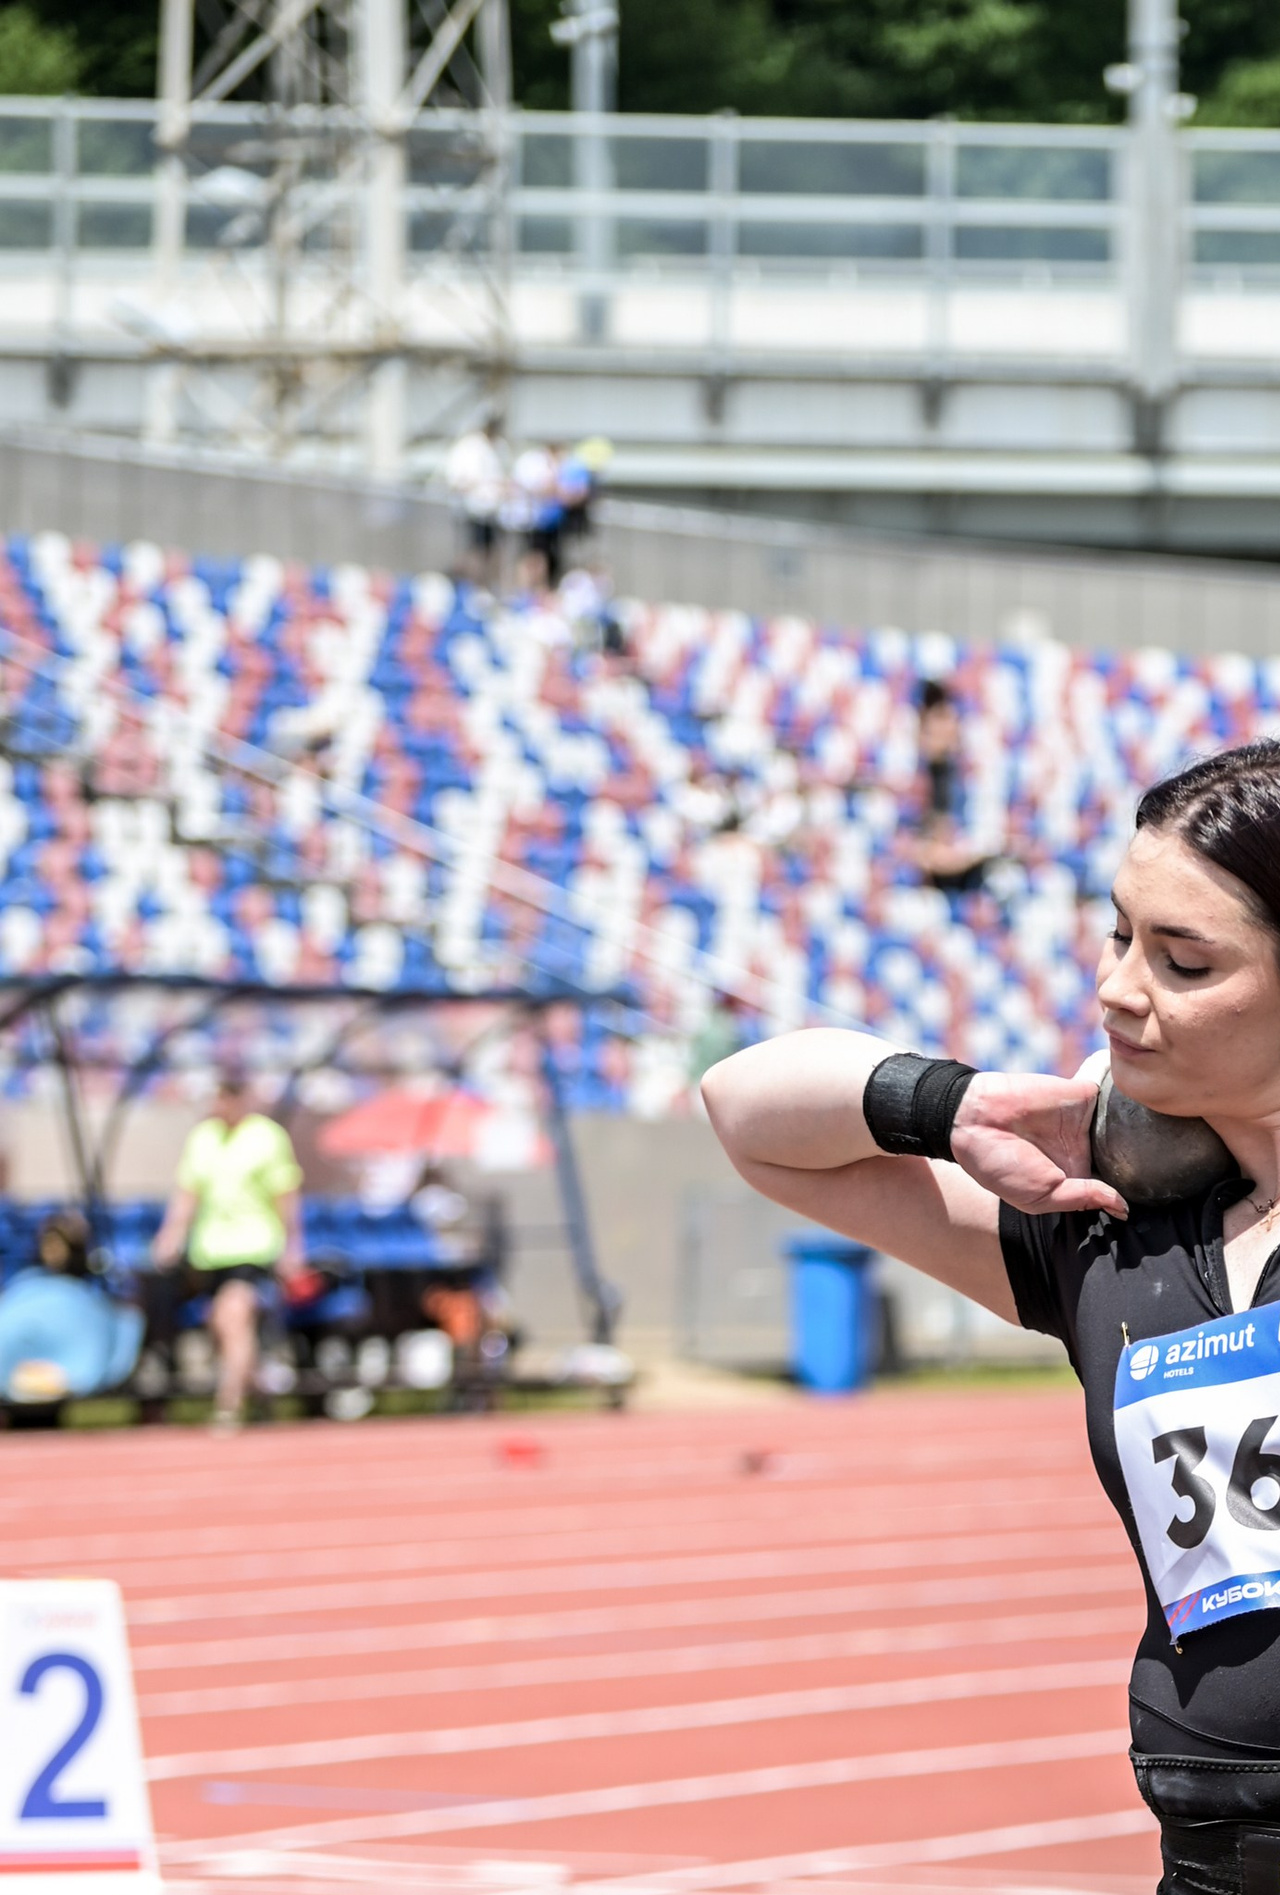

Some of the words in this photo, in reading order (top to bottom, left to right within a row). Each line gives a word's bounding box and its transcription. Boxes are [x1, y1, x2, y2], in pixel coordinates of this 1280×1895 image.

[1165, 1323, 1256, 1365] azimut
[1163, 1366, 1195, 1379] HOTELS
[20, 1653, 106, 1818] 2
